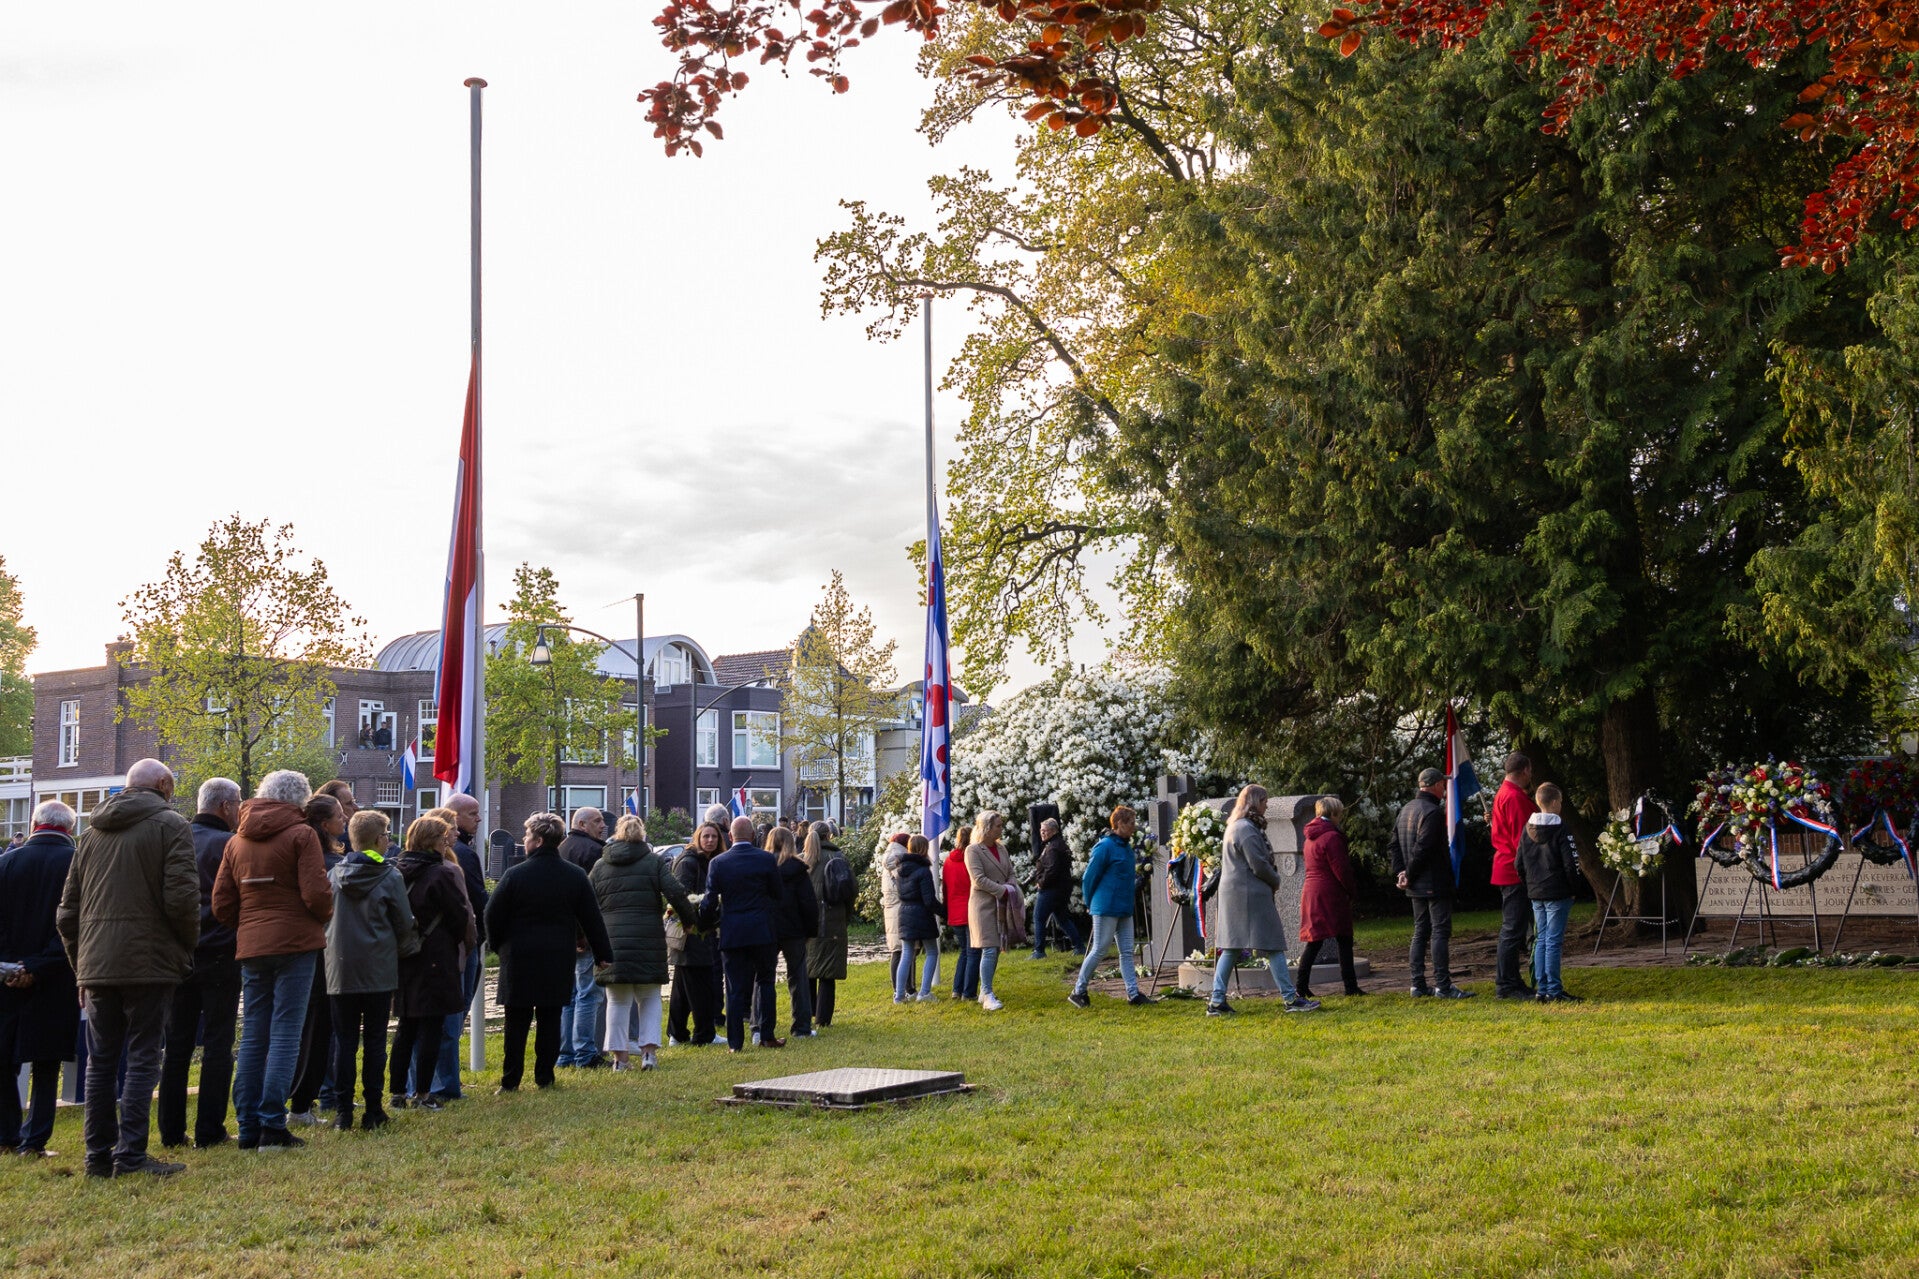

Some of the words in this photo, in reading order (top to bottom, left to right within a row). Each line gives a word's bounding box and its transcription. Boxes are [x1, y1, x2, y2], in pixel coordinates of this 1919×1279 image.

[1708, 887, 1725, 895] DIRK
[1727, 887, 1737, 895] DE
[1709, 899, 1723, 907] JAN
